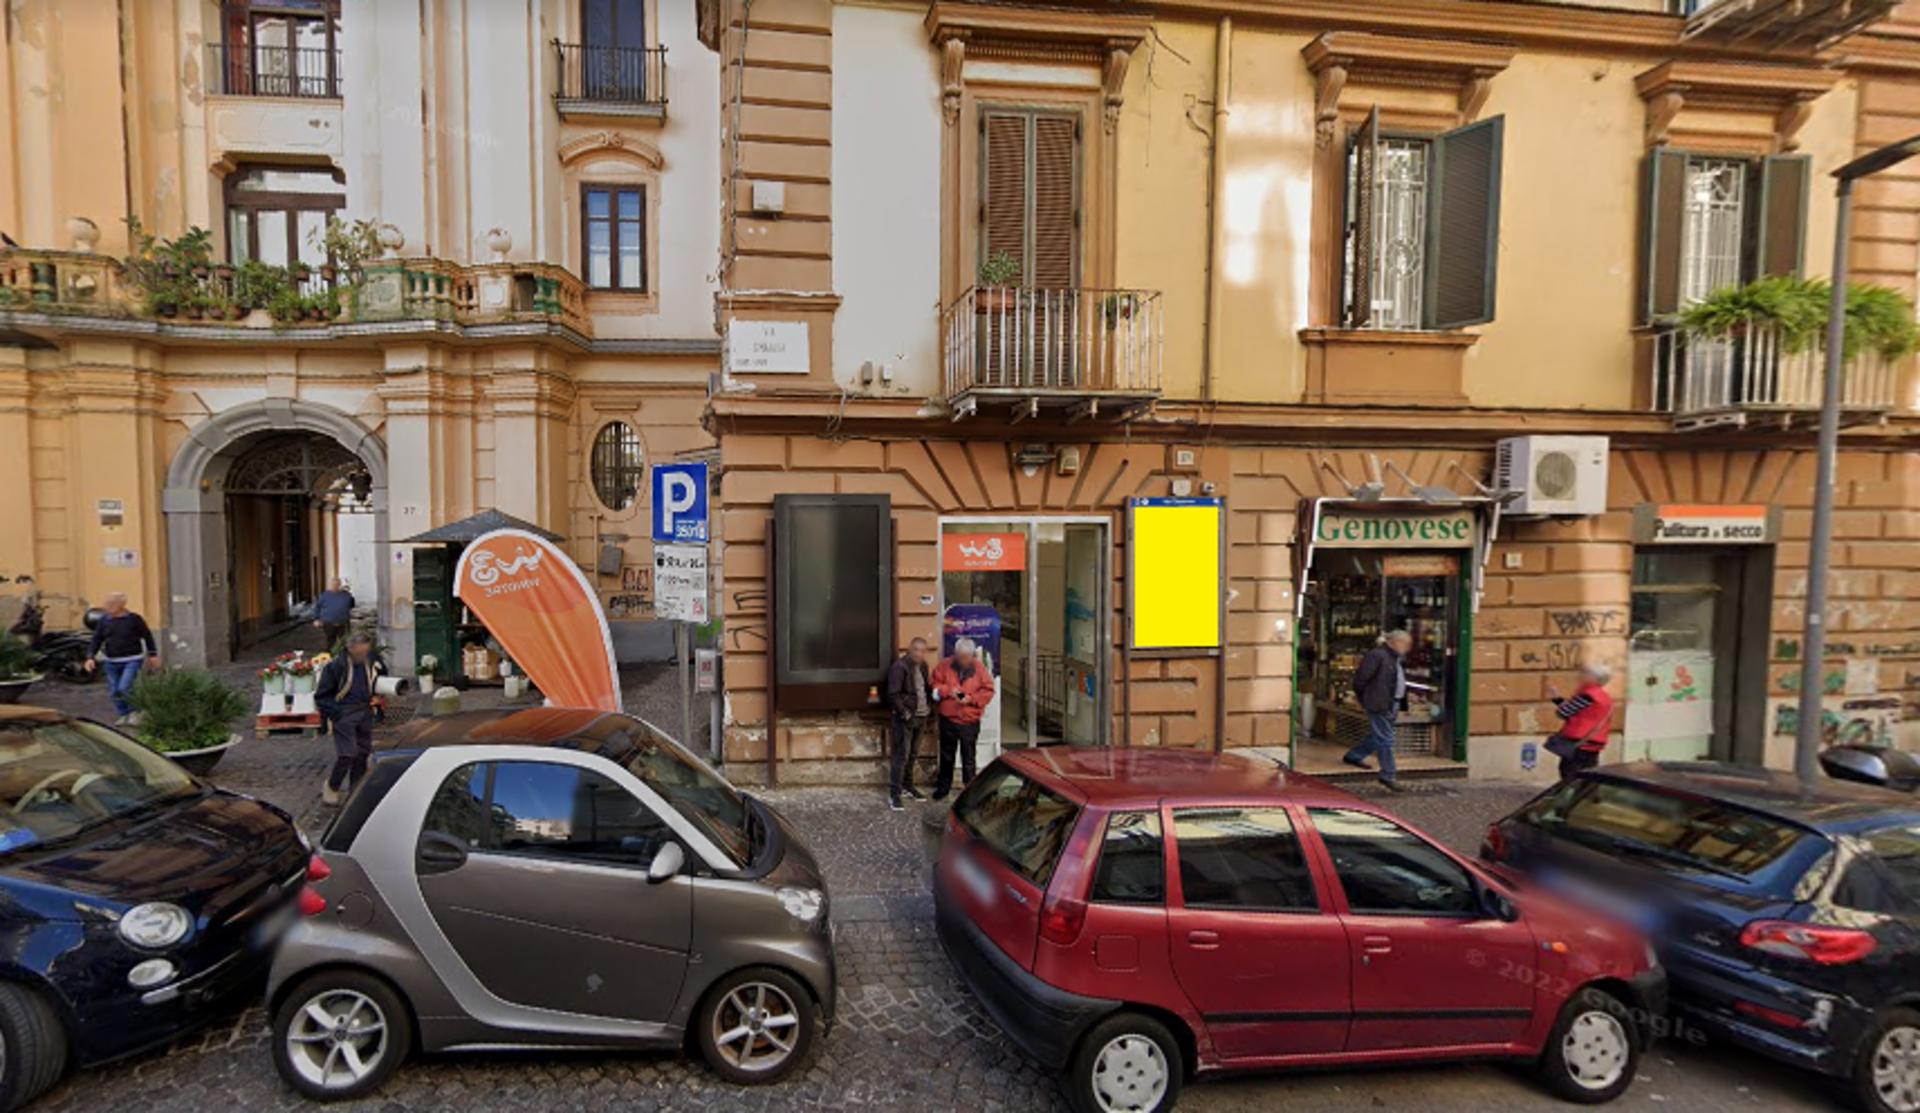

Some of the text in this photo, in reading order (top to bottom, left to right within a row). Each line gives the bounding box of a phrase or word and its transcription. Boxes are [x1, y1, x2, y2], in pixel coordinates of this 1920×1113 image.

[662, 471, 697, 534] P
[1317, 513, 1470, 541] Genovese
[1722, 526, 1762, 538] secco
